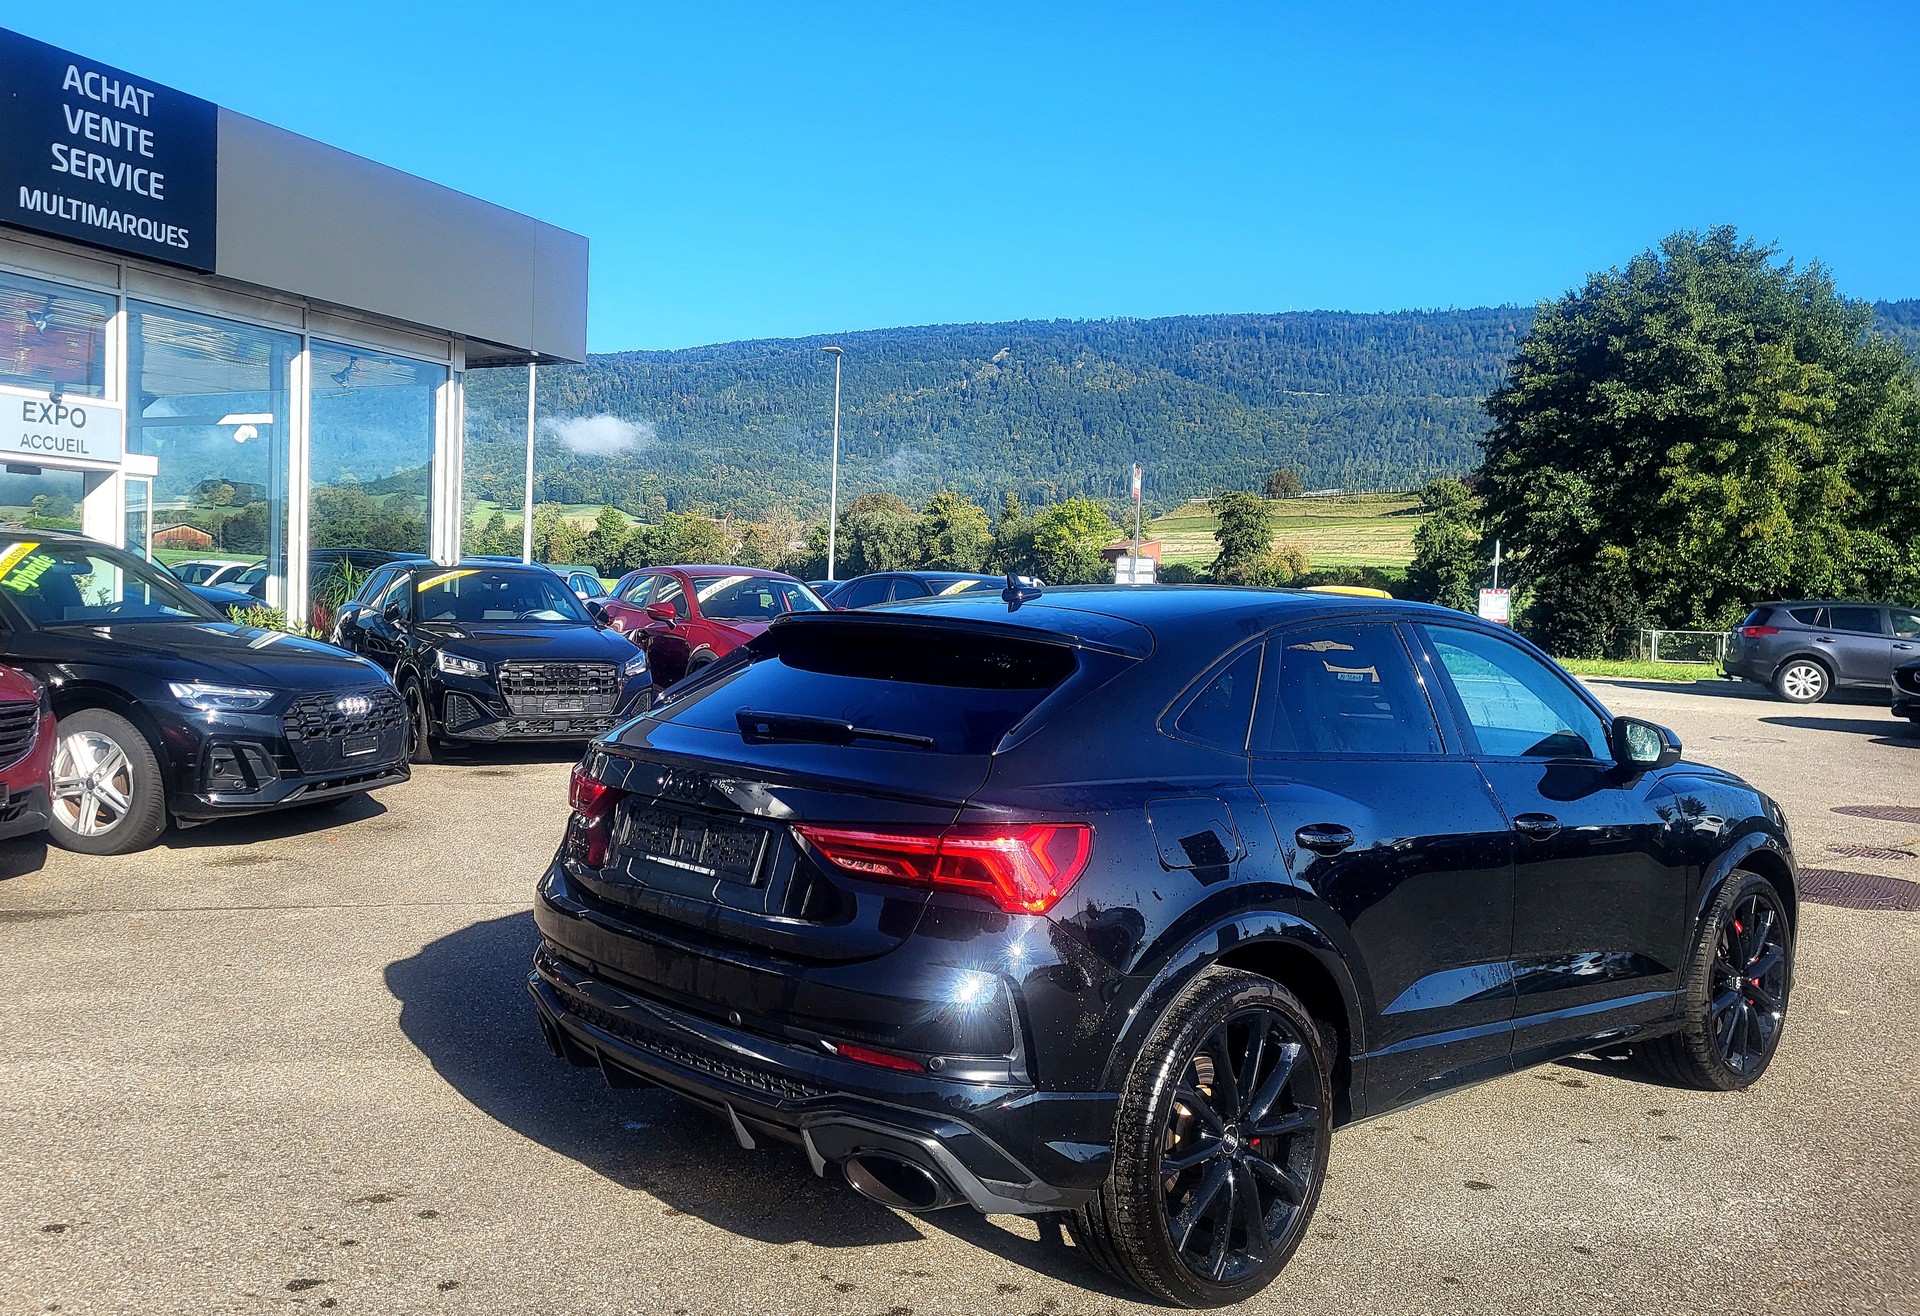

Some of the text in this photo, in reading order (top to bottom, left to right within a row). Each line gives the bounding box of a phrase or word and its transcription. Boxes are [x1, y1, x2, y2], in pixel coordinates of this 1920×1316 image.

[62, 64, 155, 117] ACHAT
[63, 103, 154, 158] VENTE
[51, 142, 164, 200] SERVICE
[19, 186, 189, 249] MULTIMARQUES
[23, 400, 87, 429] EXPO
[20, 433, 89, 454] ACCUEIL
[0, 554, 57, 592] hybride
